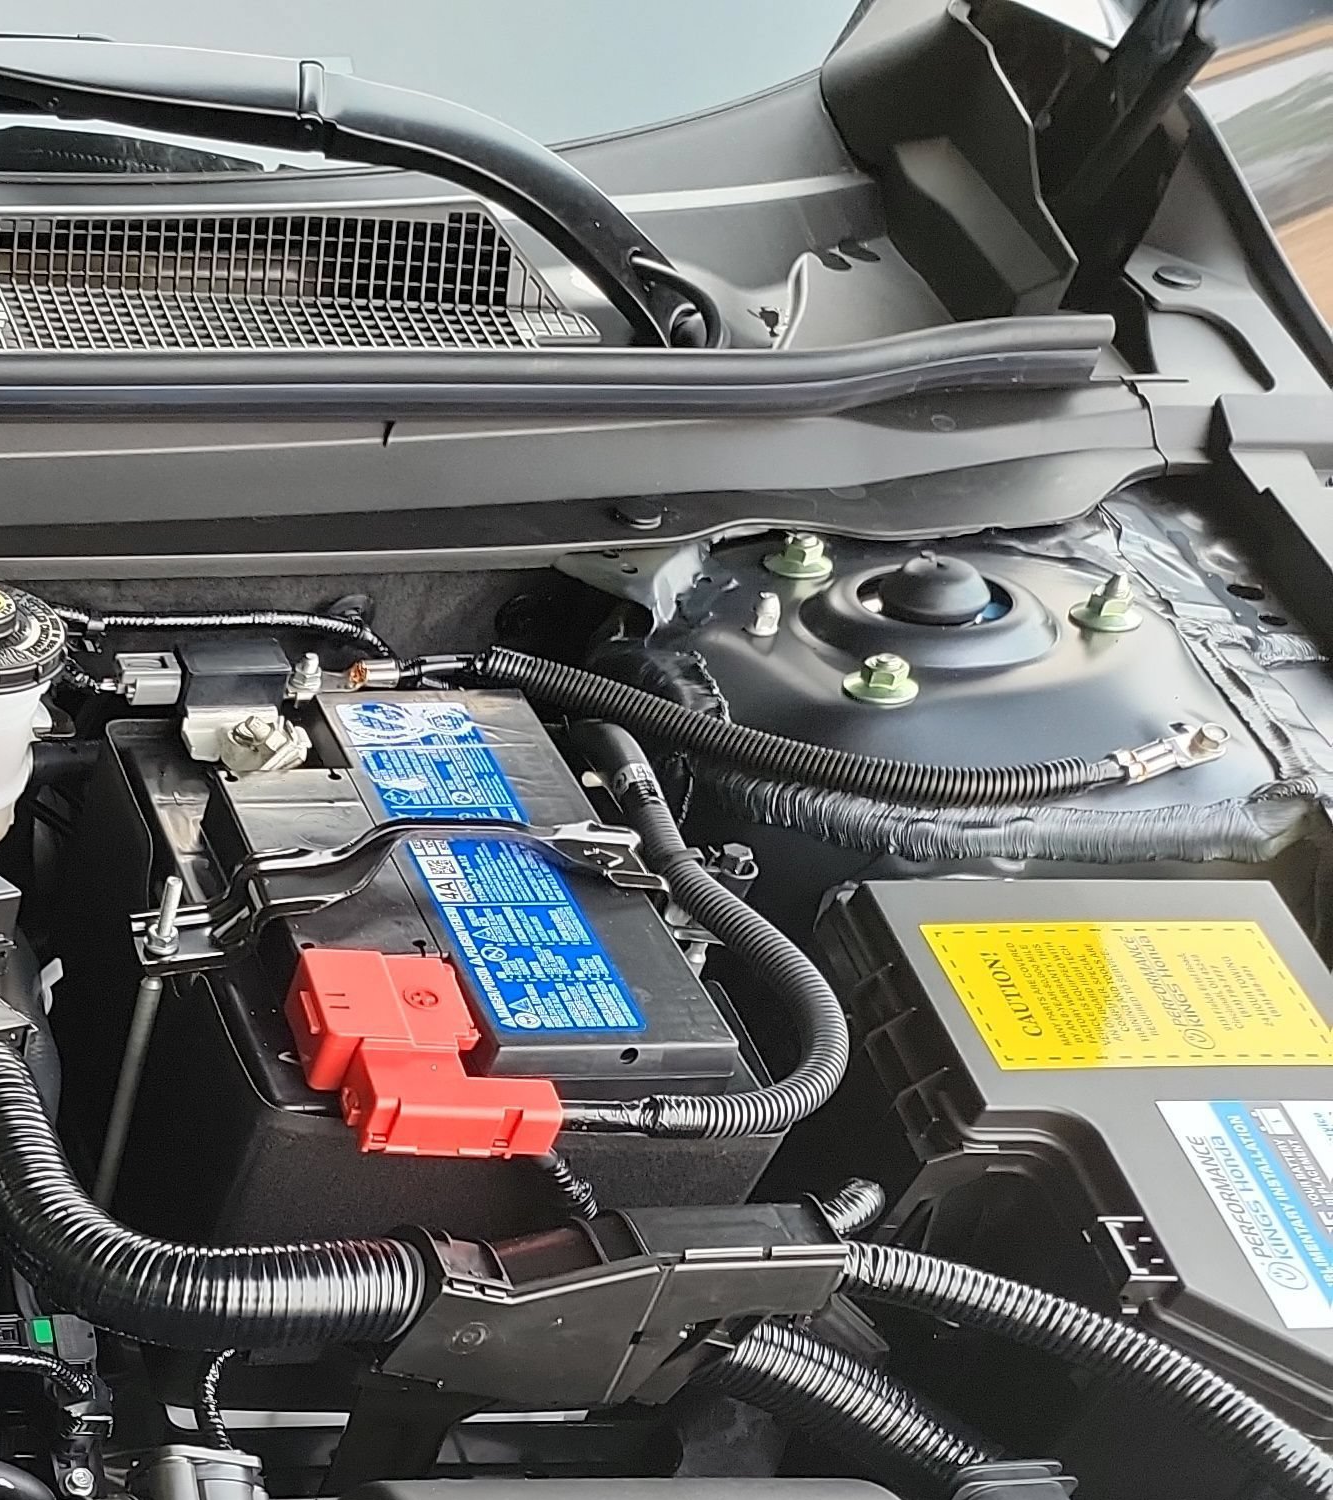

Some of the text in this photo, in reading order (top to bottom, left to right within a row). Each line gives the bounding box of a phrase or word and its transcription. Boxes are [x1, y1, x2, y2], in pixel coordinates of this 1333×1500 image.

[436, 881, 459, 900] 4A
[1018, 944, 1037, 962] MILE
[1031, 944, 1048, 959] THIS
[1042, 942, 1062, 961] WITH
[1057, 945, 1077, 964] TECH
[1055, 963, 1086, 1000] EQUIPPED
[1076, 954, 1102, 984] SPECIAL
[1092, 959, 1115, 984] TOOLS
[1119, 935, 1186, 1026] PERFORMANCE
[1134, 935, 1204, 1026] KINGS Honda
[977, 952, 1045, 1036] CAUTION!
[1004, 942, 1072, 1045] MANY PARTS ARE COVERED
[1083, 987, 1107, 1014] BOARD
[1108, 986, 1126, 1002] AND
[1120, 984, 1134, 994] TO
[1063, 1019, 1077, 1030] AN
[1069, 1008, 1098, 1043] FACTORY
[1083, 1011, 1113, 1045] VEHICLE
[1119, 1005, 1150, 1041] TRAINING
[1127, 996, 1159, 1035] REQUIRED
[1108, 1030, 1123, 1040] AN
[1225, 1115, 1288, 1199] INSTALLATION
[1272, 1139, 1323, 1206] YOUR BATTERY
[1185, 1135, 1272, 1258] PERFORMANCE
[1206, 1135, 1293, 1258] KINGS Honda
